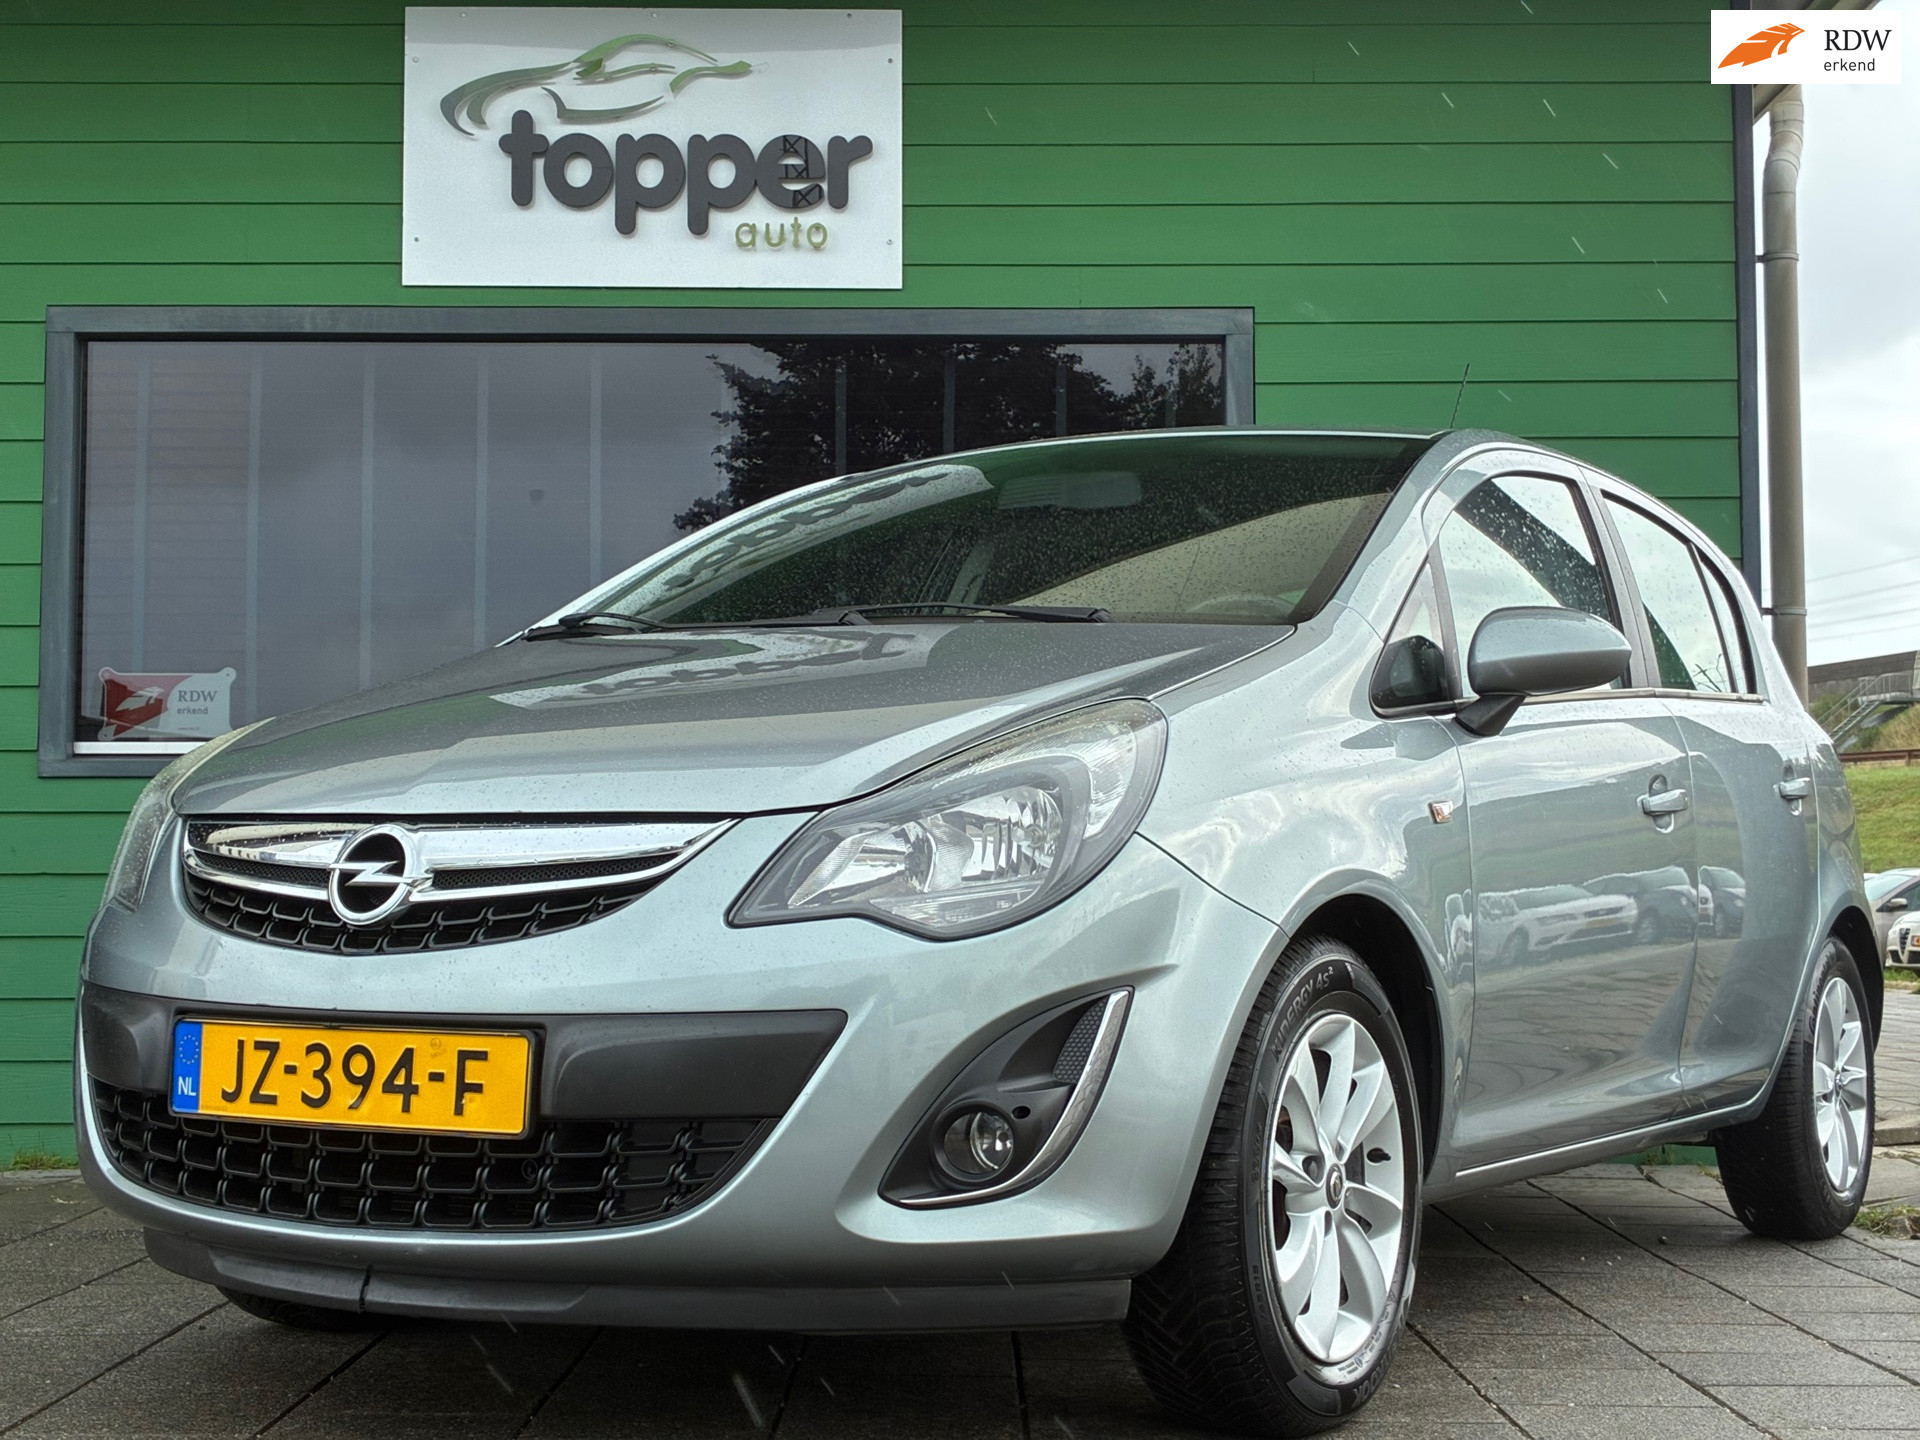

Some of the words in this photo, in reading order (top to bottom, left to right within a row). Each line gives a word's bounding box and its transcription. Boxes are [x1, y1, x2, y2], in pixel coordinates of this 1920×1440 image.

[498, 109, 874, 236] topper
[735, 218, 829, 249] auto
[178, 690, 217, 703] RDW
[177, 707, 209, 715] erkend
[178, 1075, 197, 1096] NL
[221, 1038, 489, 1117] JZ-394-F
